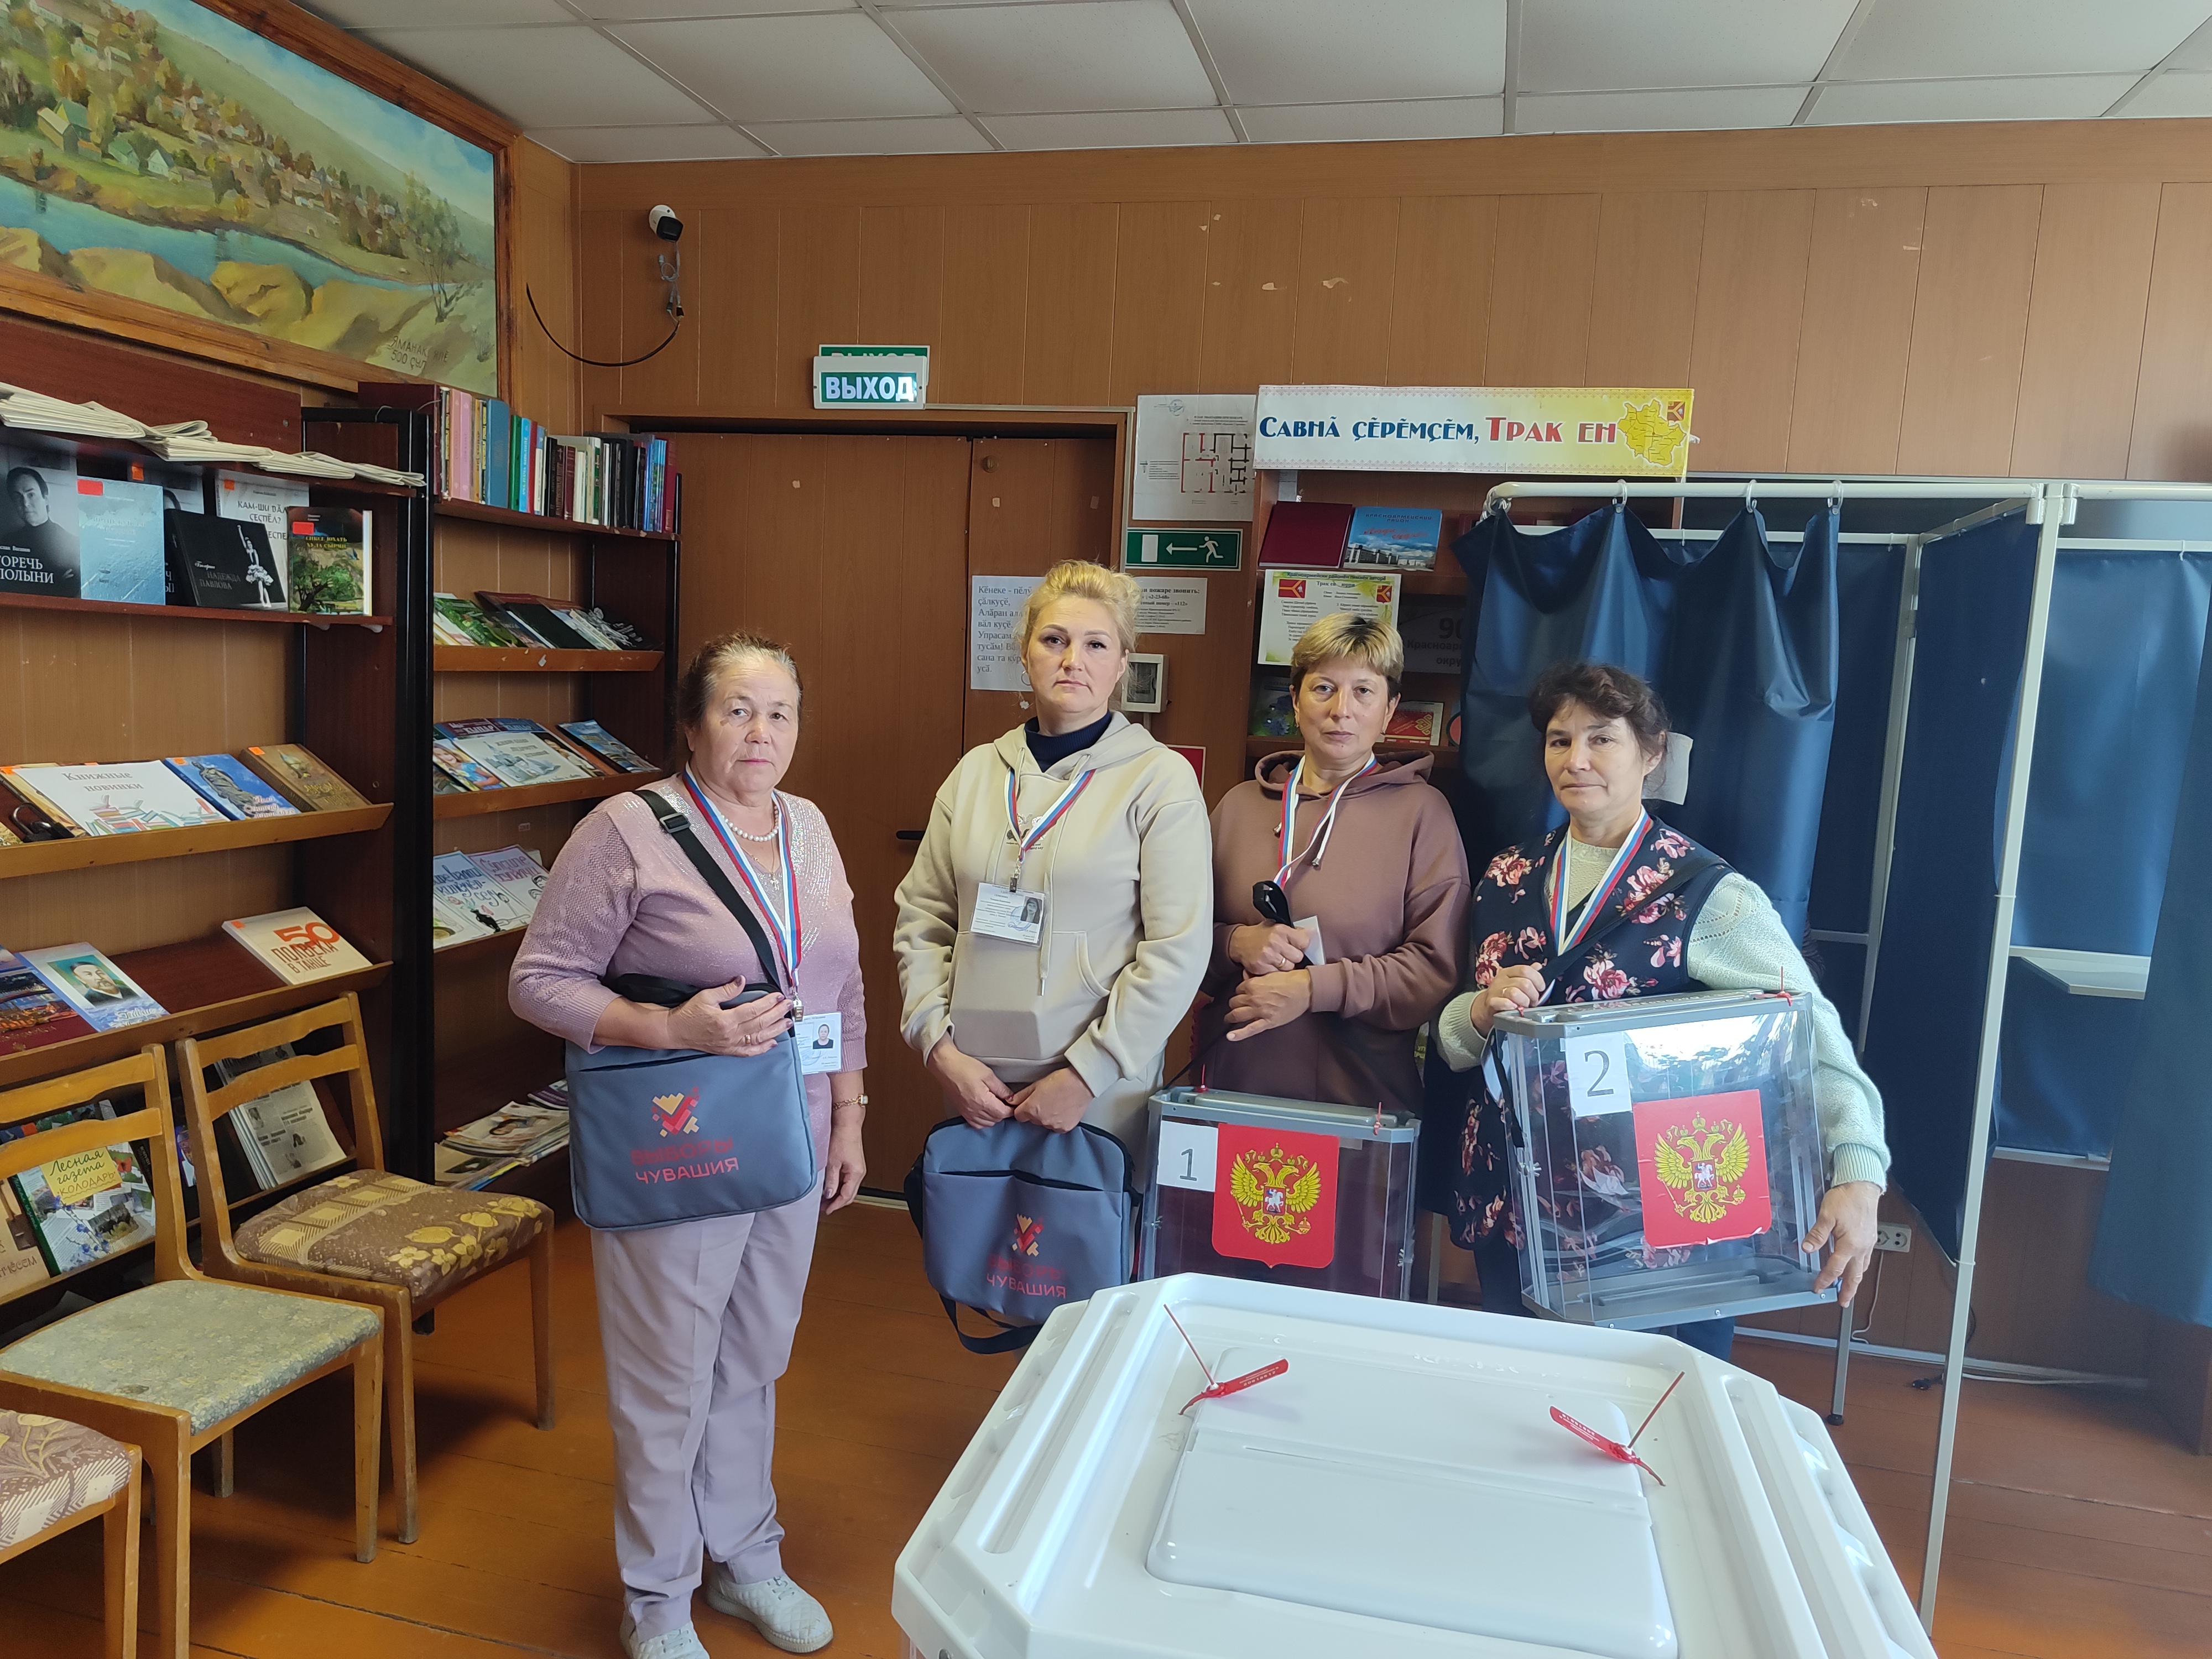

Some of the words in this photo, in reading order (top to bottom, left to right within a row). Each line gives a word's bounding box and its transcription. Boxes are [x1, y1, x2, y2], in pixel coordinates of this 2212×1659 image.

[389, 336, 427, 357] ЯМАНАК
[391, 349, 408, 364] 500
[826, 377, 914, 401] ВЫХОД
[238, 500, 269, 512] КАМ-ШИ
[268, 531, 287, 540] ЕСПЕ
[0, 555, 43, 570] ОРЕЧЬ
[199, 578, 233, 590] ПАВЛОВА
[207, 571, 241, 582] НАДЕЖДА
[1436, 658, 1462, 667] окру
[61, 771, 133, 781] Книжные
[83, 783, 144, 792] новинки
[273, 922, 340, 946] 50
[270, 940, 339, 963] ПОЛВЕКА
[287, 962, 301, 973] В
[296, 956, 332, 971] ТАНЦЕ
[1584, 1050, 1615, 1097] 2
[630, 1137, 734, 1166] ВЫБОРЫ
[50, 1150, 104, 1176] Лесная
[57, 1162, 105, 1185] газета
[635, 1157, 739, 1185] ЧУВАШИЯ
[1179, 1148, 1197, 1181] 1
[987, 1273, 1066, 1298] ЧУВАШИЯ
